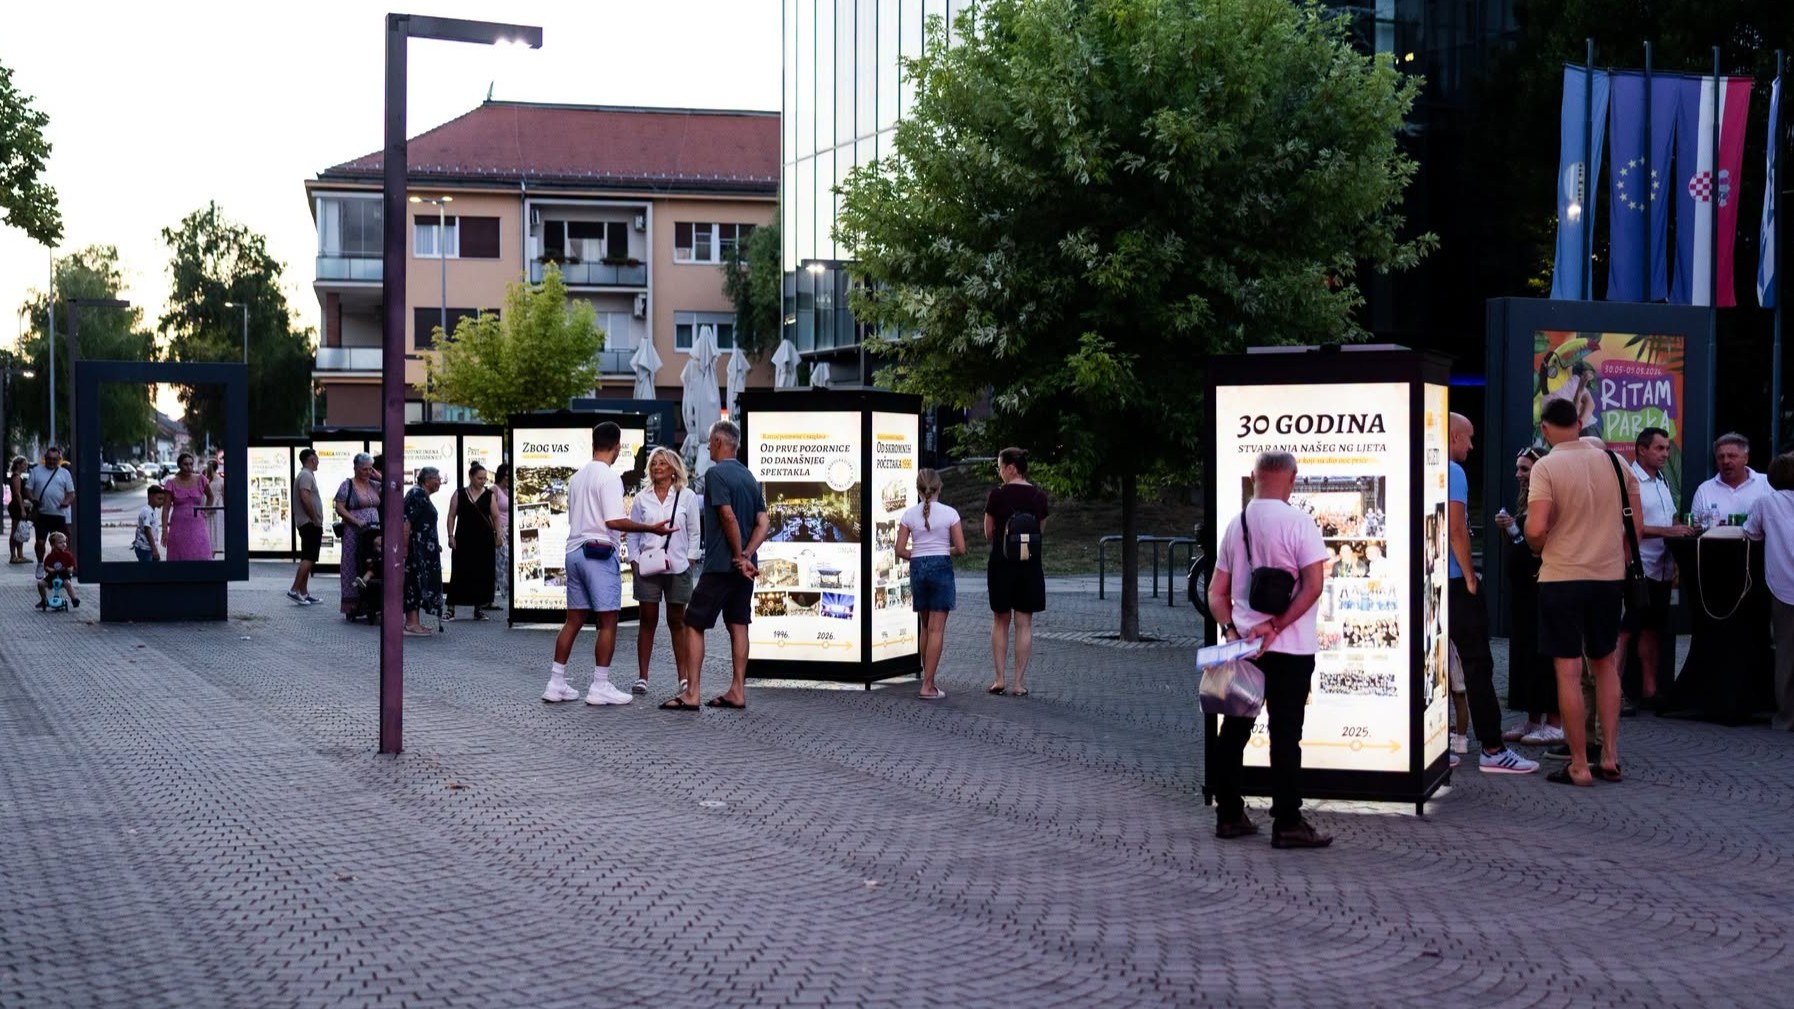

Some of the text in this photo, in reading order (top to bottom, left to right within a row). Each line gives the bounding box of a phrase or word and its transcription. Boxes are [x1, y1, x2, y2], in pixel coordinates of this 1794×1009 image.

[1237, 413, 1386, 438] 30 GODINA
[776, 444, 798, 453] PRVE
[799, 444, 850, 453] POZORNICE
[885, 444, 912, 454] SKROMNIH
[1300, 441, 1336, 452] NAŠEG
[1338, 444, 1354, 452] NG
[1356, 444, 1387, 452] LJETA
[760, 454, 825, 466] DO DANAŠNJEG
[773, 630, 790, 639] 1996.
[817, 632, 835, 640] 2026.
[1250, 724, 1269, 734] 021
[1342, 726, 1371, 737] 2025.
